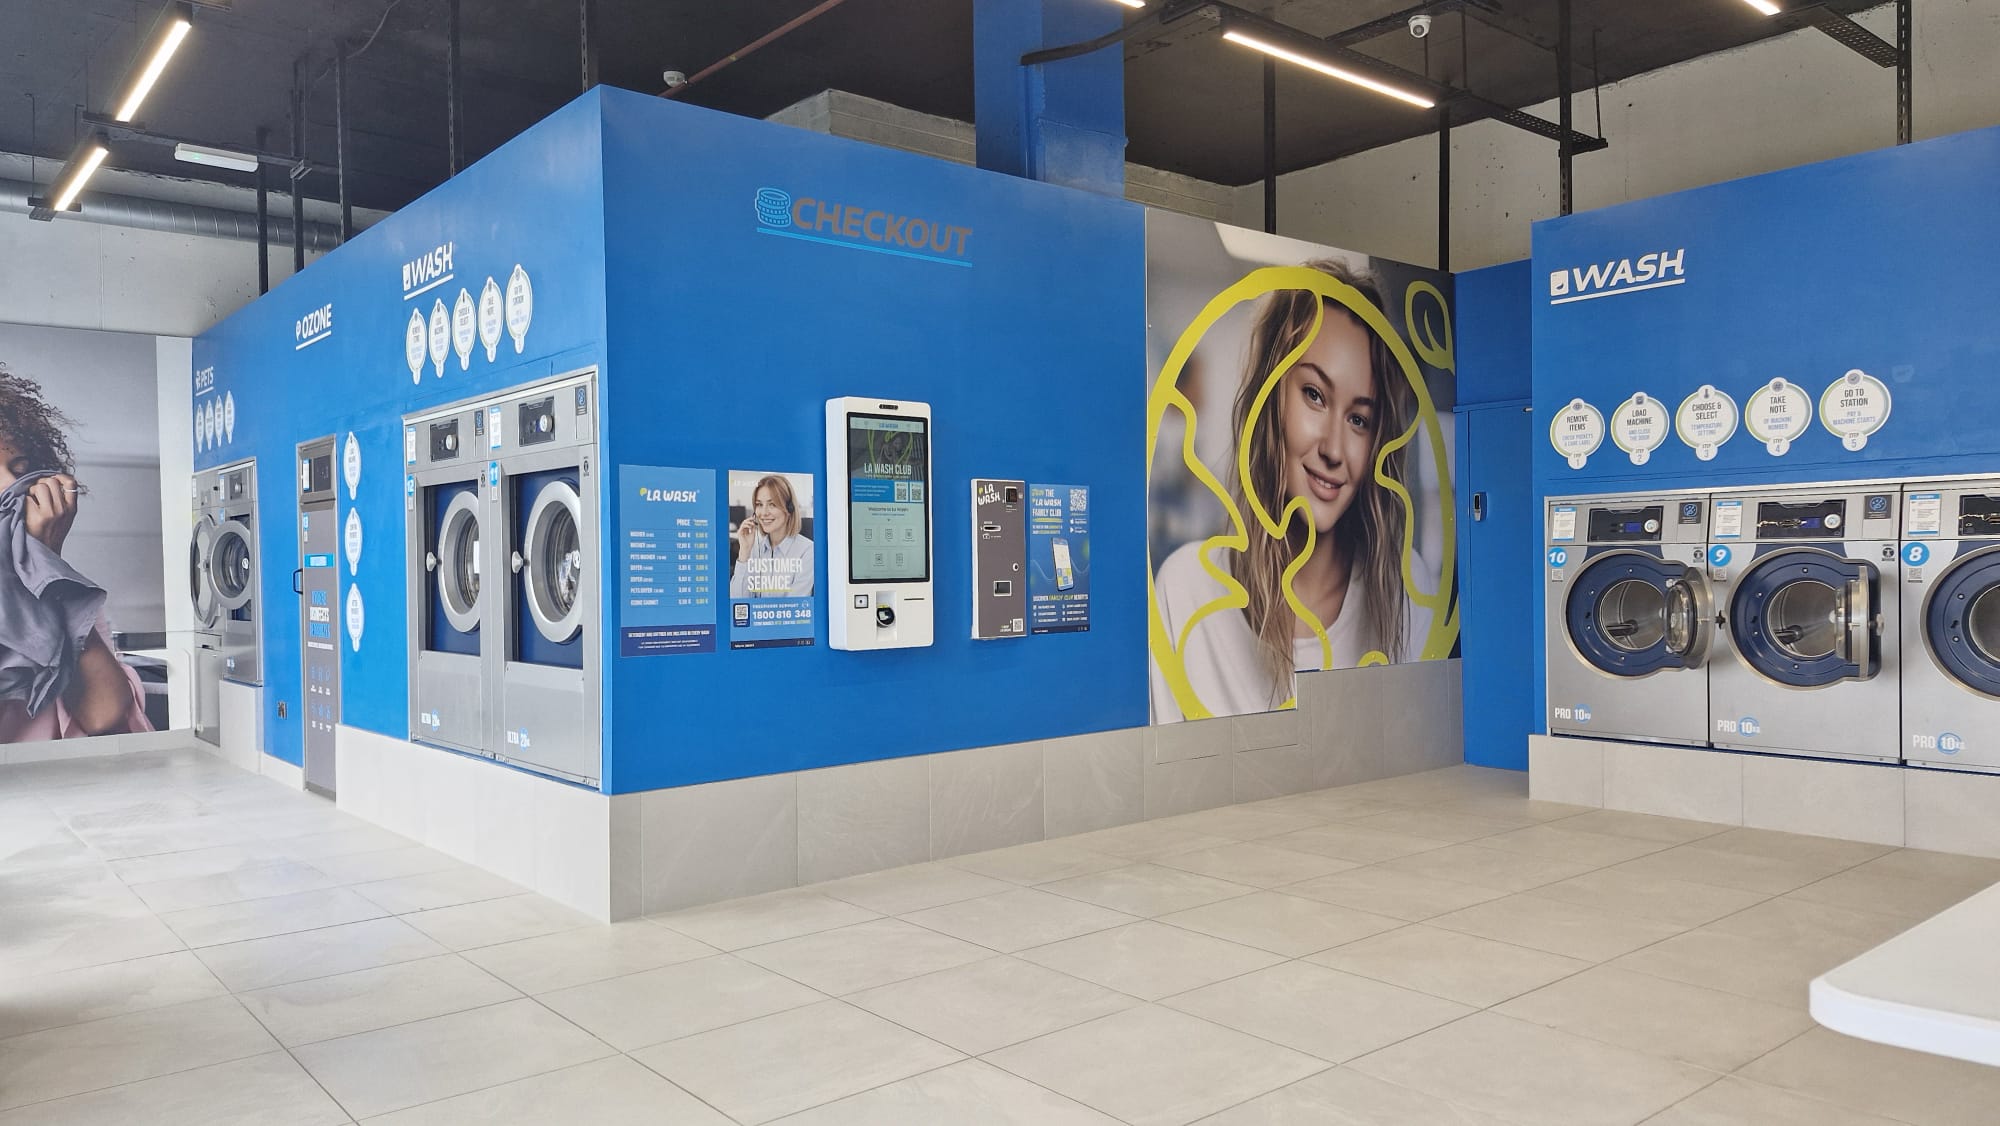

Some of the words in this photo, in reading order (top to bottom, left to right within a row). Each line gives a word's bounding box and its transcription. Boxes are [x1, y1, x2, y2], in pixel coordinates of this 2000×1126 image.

[792, 197, 973, 256] CHECKOUT
[411, 241, 453, 287] WASH
[1573, 248, 1684, 292] WASH
[302, 303, 332, 339] OZONE
[201, 366, 214, 389] PETS
[1692, 403, 1715, 411] CHOOSE
[1840, 398, 1868, 407] STATION
[1632, 409, 1646, 418] LOAD
[1770, 405, 1786, 413] NOTE
[1566, 415, 1588, 423] REMOVE
[1627, 417, 1652, 426] MACHINE
[1696, 411, 1717, 420] SELECT
[1569, 423, 1586, 432] ITEMS
[1776, 444, 1780, 452] 4
[1851, 439, 1856, 448] 5
[490, 467, 498, 480] 11
[864, 463, 872, 473] LA
[874, 463, 894, 474] WASH
[895, 464, 912, 475] CLUB
[407, 480, 414, 492] 12
[985, 484, 994, 494] LA
[646, 490, 661, 501] LA
[663, 490, 696, 502] WASH
[978, 492, 1000, 505] WASH
[1045, 489, 1054, 497] THE
[1549, 552, 1566, 563] 10
[1714, 549, 1727, 562] 9
[1909, 546, 1923, 562] 8
[748, 558, 802, 573] CUSTOMER
[748, 576, 791, 590] SERVICE
[752, 611, 775, 619] 1800
[1554, 707, 1571, 720] PRO
[1717, 720, 1736, 733] PRO
[1912, 735, 1936, 749] PRO
